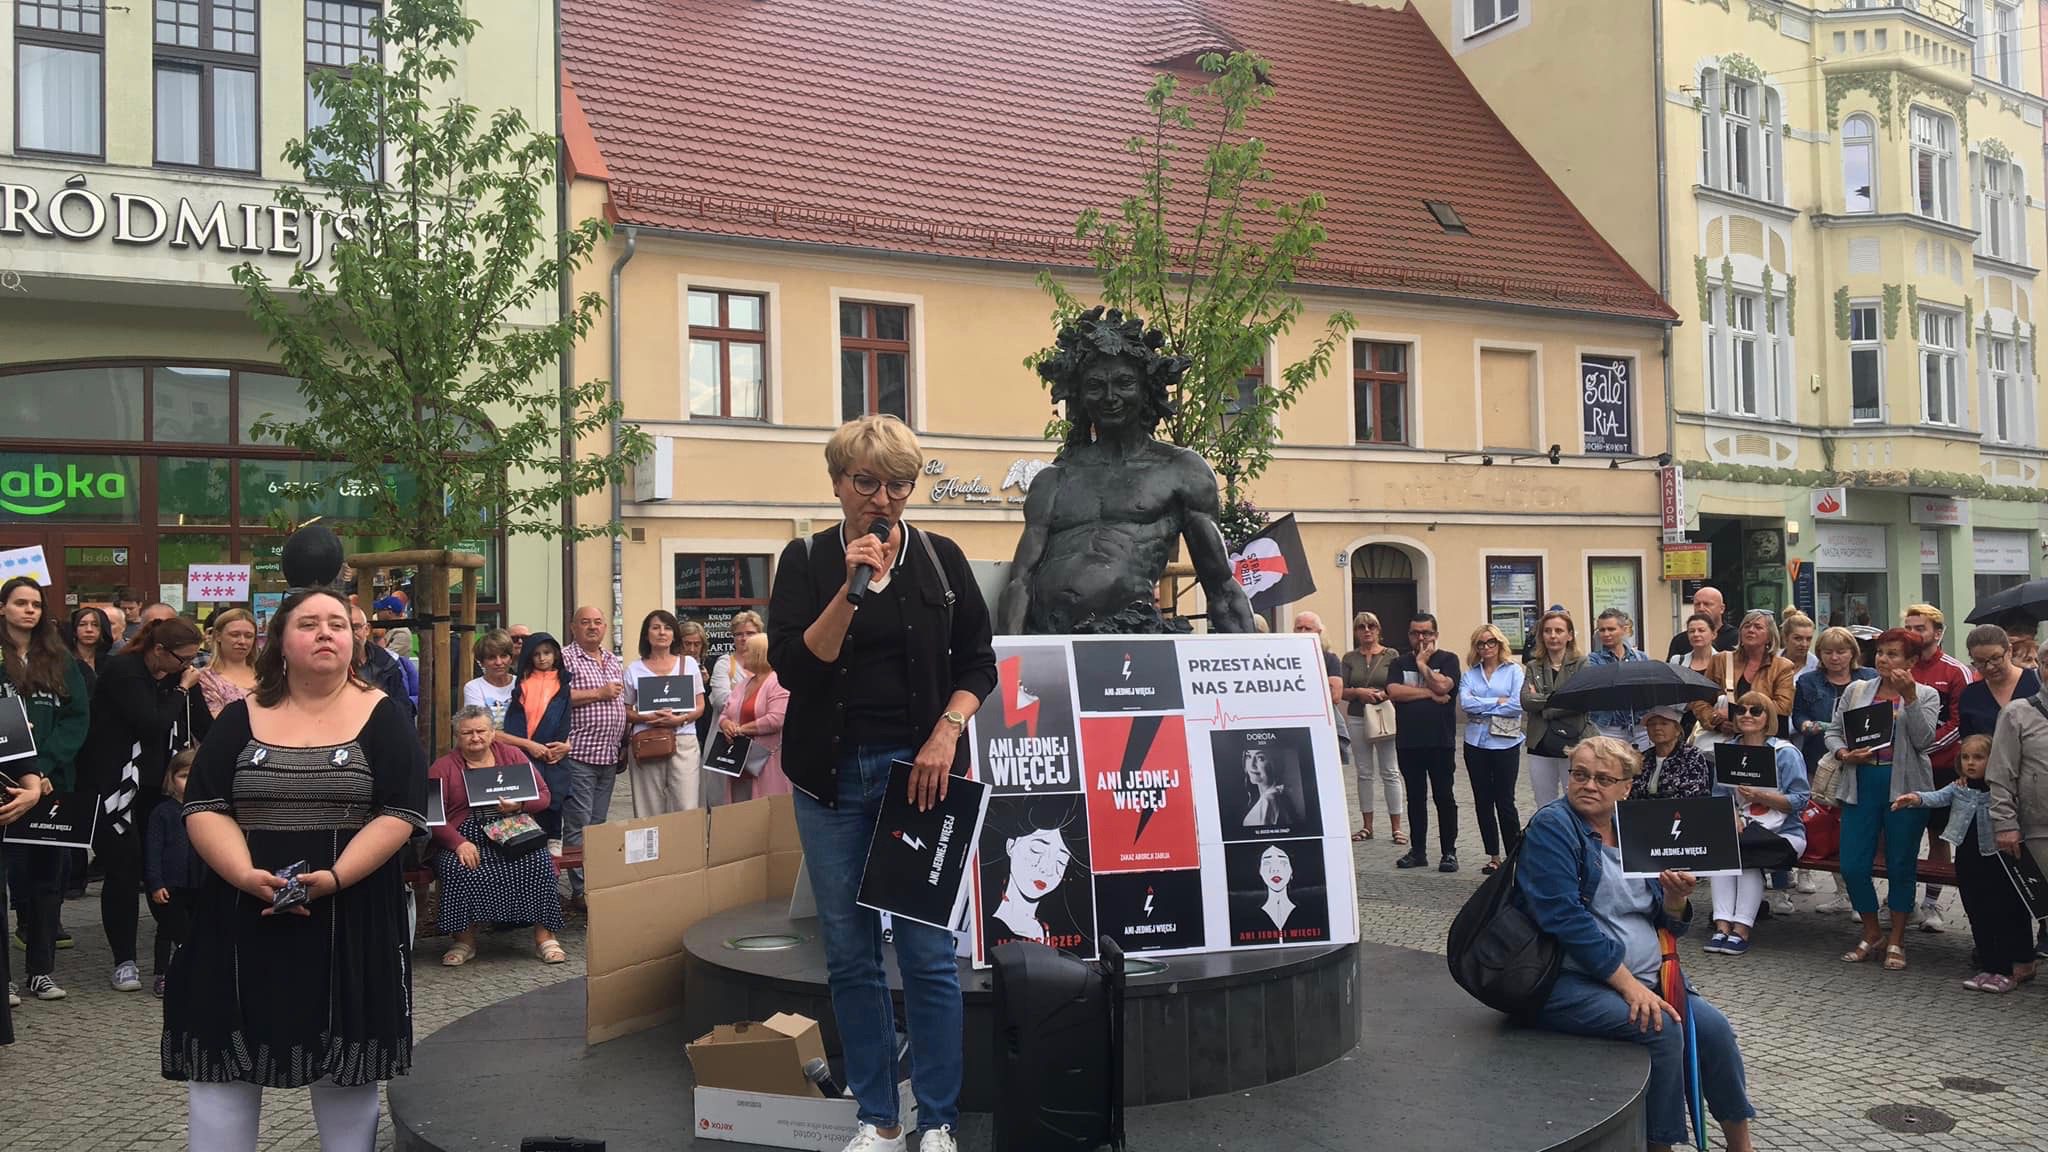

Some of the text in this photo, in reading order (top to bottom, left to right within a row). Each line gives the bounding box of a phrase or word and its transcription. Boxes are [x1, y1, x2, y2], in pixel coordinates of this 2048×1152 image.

[925, 459, 944, 475] Pod
[1, 464, 125, 498] abka
[1665, 470, 1675, 523] KANTOR
[1339, 553, 1347, 563] 21
[705, 630, 734, 639] ŚWIEC
[708, 642, 735, 652] ARTK
[1188, 653, 1302, 673] PRZESTAŃCIE
[1104, 687, 1114, 696] ANI
[1191, 674, 1306, 695] NAS ZABIJAĆ
[1246, 732, 1276, 741] DOROTA
[989, 736, 1069, 758] ANI JEDNEJ
[989, 755, 1071, 791] WIĘCEJ
[1097, 769, 1179, 790] ANI JEDNEJ
[928, 815, 955, 886] ANI JEDNEJ WIĘCEJ
[1650, 846, 1707, 857] ANI JEDNEJ WIĘCEJ
[1124, 923, 1177, 935] ANI JEDNEJ WIĘCEJ
[711, 1121, 734, 1132] xerox
[793, 1130, 822, 1142] Coated
